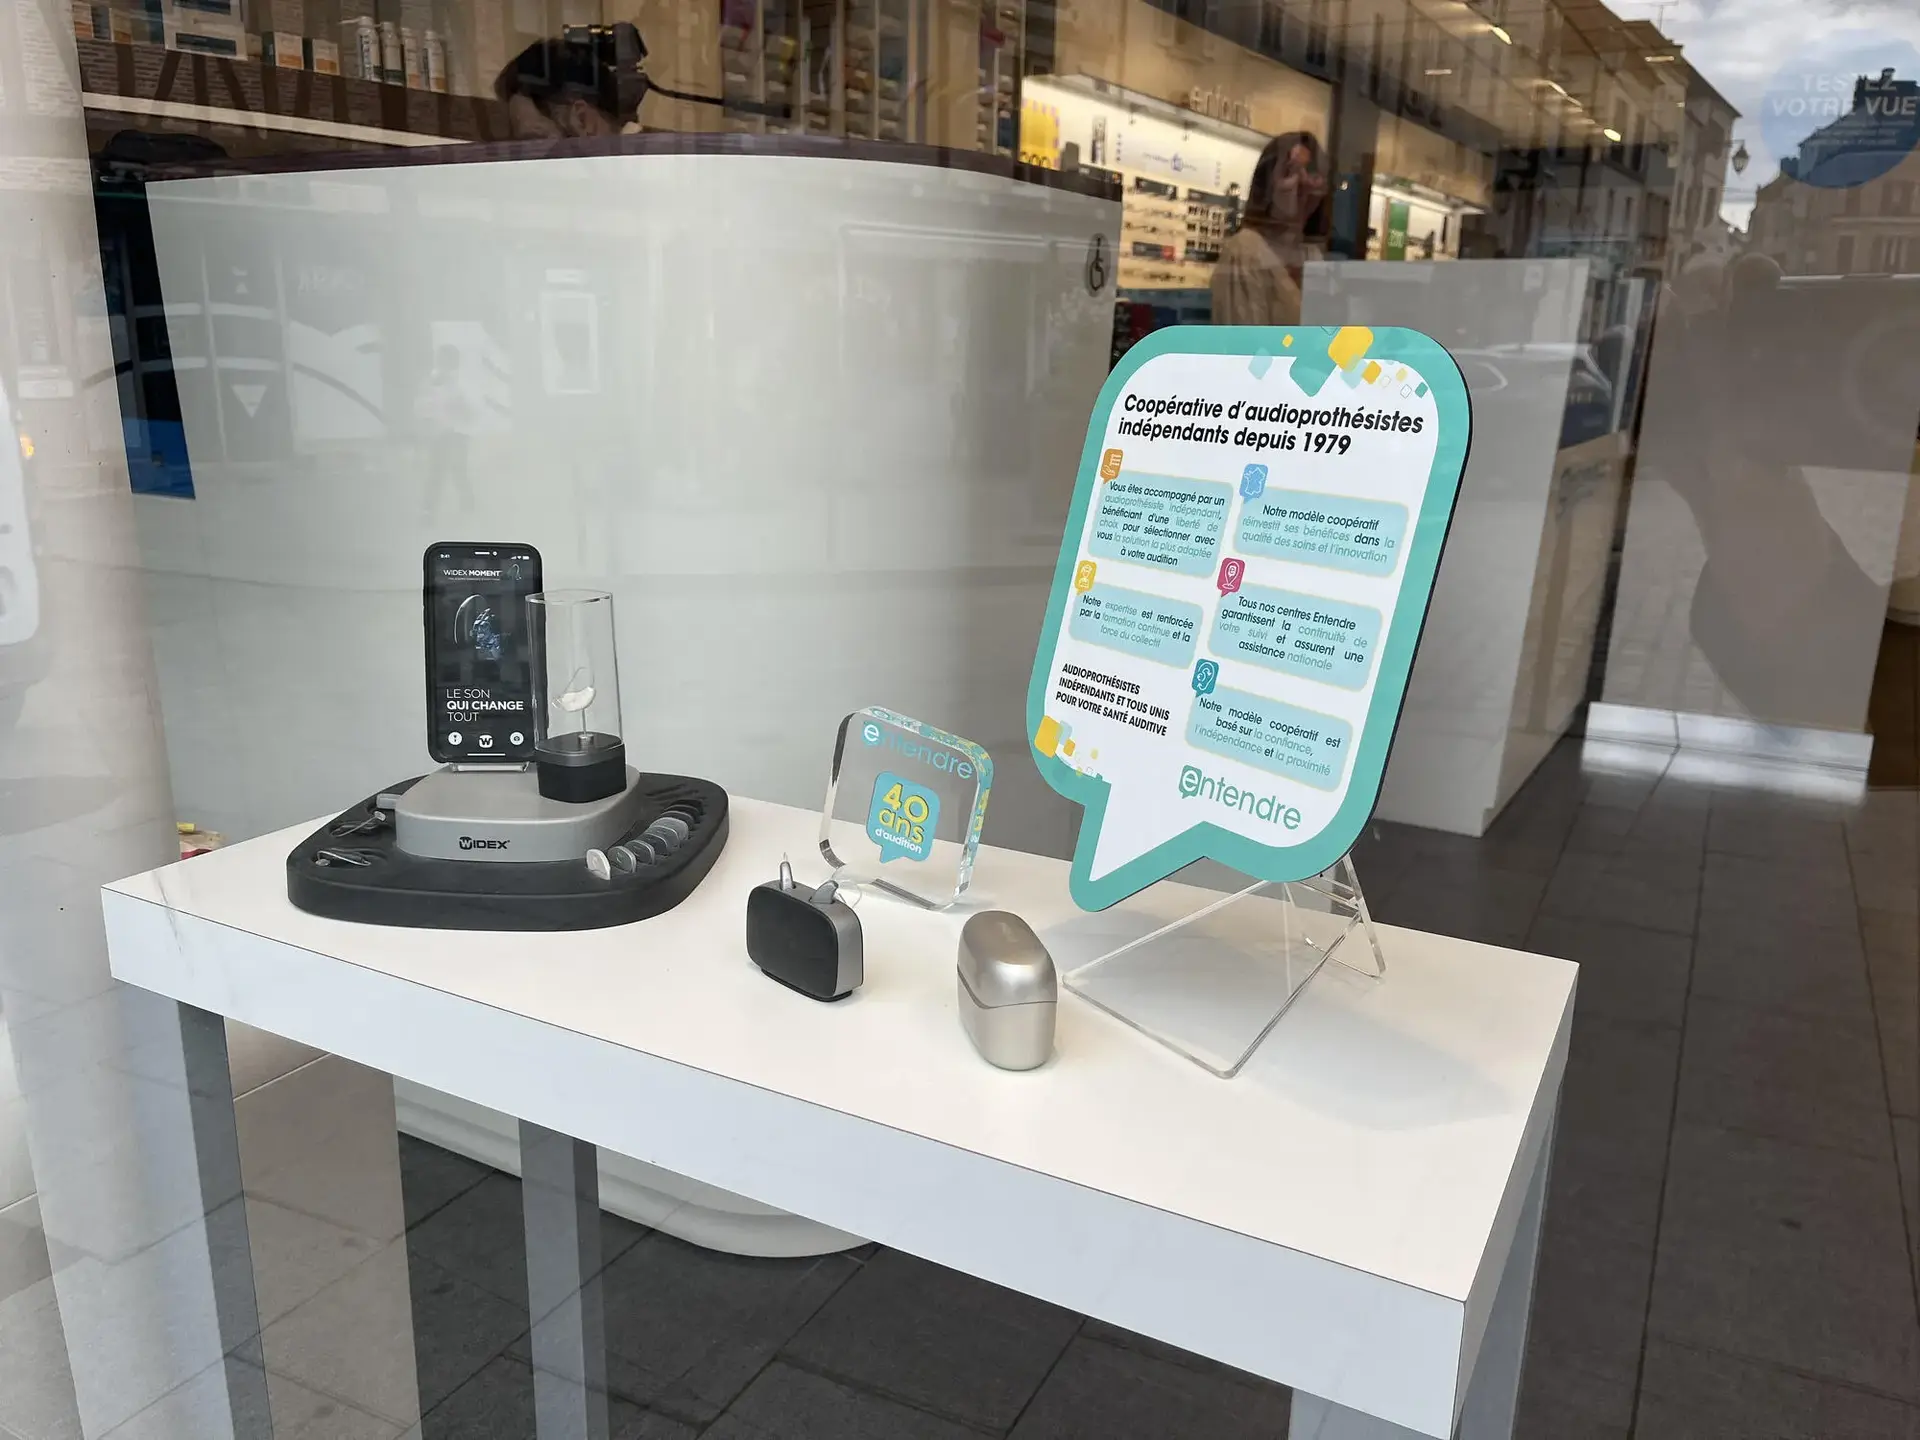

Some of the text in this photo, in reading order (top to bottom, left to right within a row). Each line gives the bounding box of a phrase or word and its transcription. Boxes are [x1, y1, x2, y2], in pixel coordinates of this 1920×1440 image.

[1803, 73, 1896, 92] TESTEZ
[1772, 96, 1917, 116] VOTRE VUE
[1124, 394, 1222, 418] Coopérative
[1118, 417, 1351, 455] indépendants depuis 1979
[1104, 494, 1222, 520] audioprothésiste indépendant,
[1110, 481, 1225, 506] Vous êtes accompagné par un
[1100, 518, 1215, 545] choix pour sélectionner avec
[1102, 506, 1142, 520] bénéficiant
[1176, 517, 1200, 529] liberté
[1207, 522, 1218, 533] de
[1242, 516, 1395, 549] réinvestit ses bénéfices dans la
[1262, 505, 1380, 531] Notre modèle coopératif
[1097, 531, 1212, 559] vous la solution la plus adaptée
[1121, 546, 1178, 566] à votre audition
[1241, 531, 1272, 544] qualité
[1274, 536, 1291, 547] des
[1293, 539, 1316, 552] soins
[1318, 543, 1328, 553] et
[443, 569, 468, 577] WIDEX
[1080, 608, 1191, 642] par la formation continue et la
[1082, 595, 1194, 630] Notre expertise est renforcée
[1238, 596, 1356, 630] Tous nos centres Entendre
[1100, 624, 1161, 648] force du collectif
[1219, 622, 1364, 663] votre suivi et assurent une
[1221, 608, 1368, 649] garantissent la continuité de
[1238, 640, 1333, 671] assistance nationale
[446, 688, 491, 699] LE SON
[1062, 663, 1141, 695] AUDIOPROTHÉSISTES
[446, 701, 524, 711] QUI CHANGE
[1056, 691, 1167, 736] POUR VOTRE SANTÉ AUDITIVE
[1059, 677, 1170, 721] INDÉPENDANTS ET TOUS UNIS
[447, 711, 479, 722] TOUT
[1199, 698, 1341, 748] Notre modèle coopératif est
[862, 721, 975, 780] entendre
[1215, 716, 1314, 757] basé sur la confiance,
[1264, 746, 1274, 758] et
[1275, 750, 1284, 762] la
[1286, 753, 1331, 776] proximité
[883, 783, 930, 824] 40
[1178, 765, 1301, 830] entendre
[878, 807, 925, 844] ans
